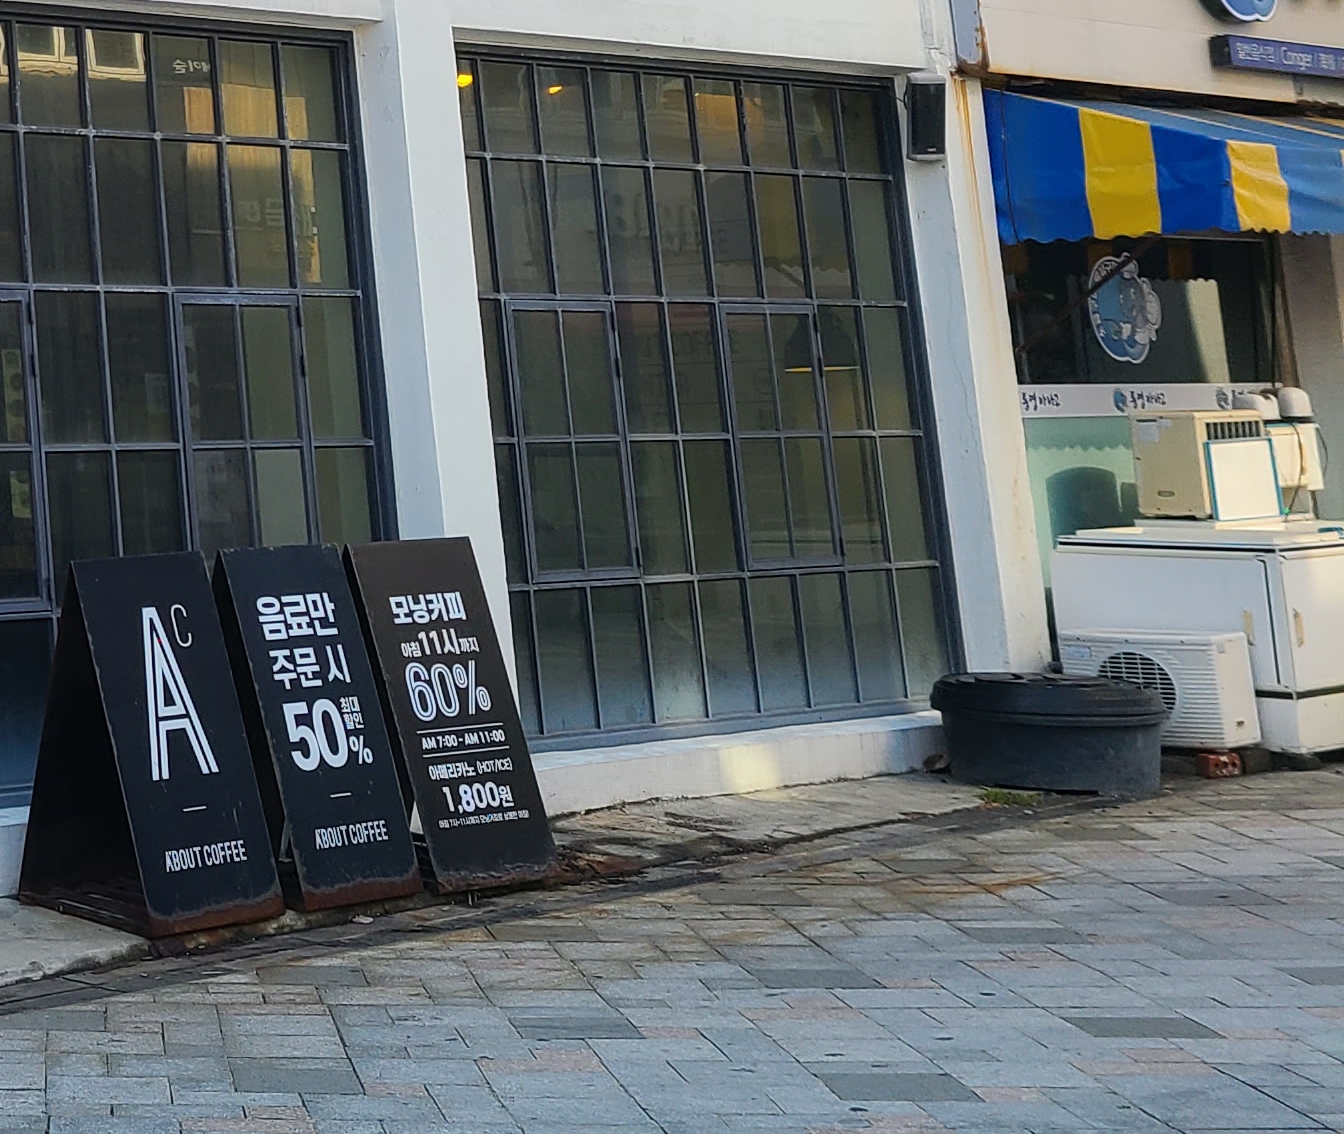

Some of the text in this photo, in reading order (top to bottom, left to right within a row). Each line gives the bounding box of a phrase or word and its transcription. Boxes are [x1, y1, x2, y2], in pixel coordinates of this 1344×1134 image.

[256, 592, 339, 641] 음료만
[389, 591, 467, 624] 모닝커피
[268, 644, 352, 690] 주문 시
[340, 696, 360, 713] 최대
[405, 659, 492, 722] 60%
[343, 712, 364, 730] 할인
[421, 737, 438, 750] AM
[438, 734, 458, 747] 7:00
[464, 733, 480, 746] AM
[479, 729, 505, 743] 11:00
[428, 761, 477, 780] 아메리카노
[441, 781, 515, 814] 1,800원
[348, 819, 389, 845] COFFEE
[201, 839, 248, 867] COFFEE
